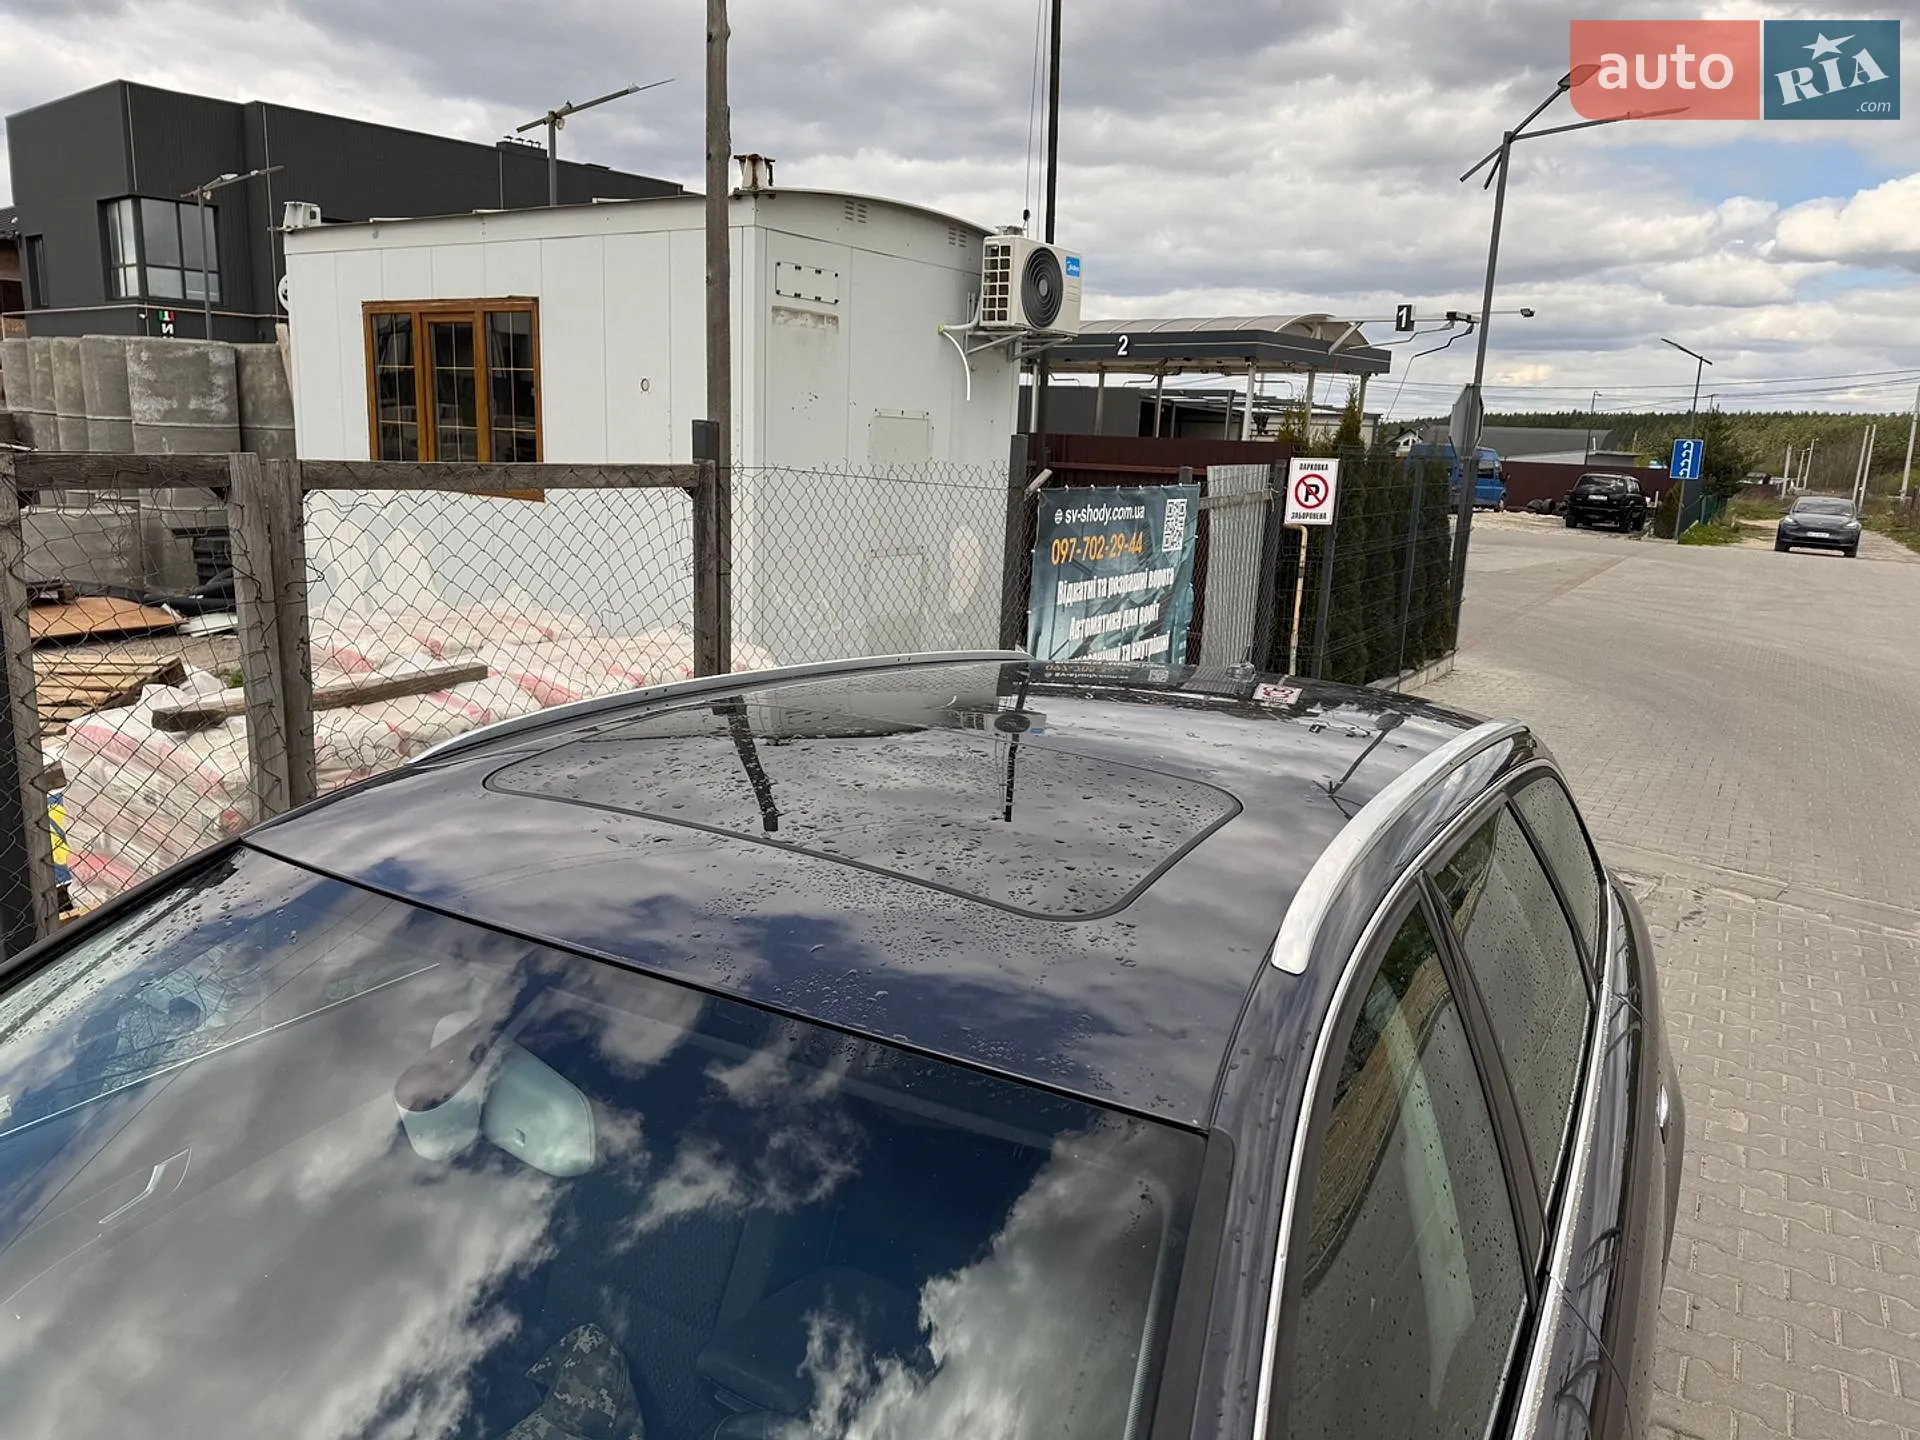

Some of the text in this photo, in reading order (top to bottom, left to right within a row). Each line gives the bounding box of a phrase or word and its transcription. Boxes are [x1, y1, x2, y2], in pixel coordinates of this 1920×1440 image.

[1398, 306, 1408, 329] 1
[1117, 334, 1129, 356] 2
[1065, 503, 1145, 526] sv-shody.com.ua
[1051, 531, 1144, 565] 097-702-29-44
[1057, 575, 1097, 607] Відкатні
[1097, 577, 1107, 598] та
[1069, 600, 1160, 641] Автоматика для воріт
